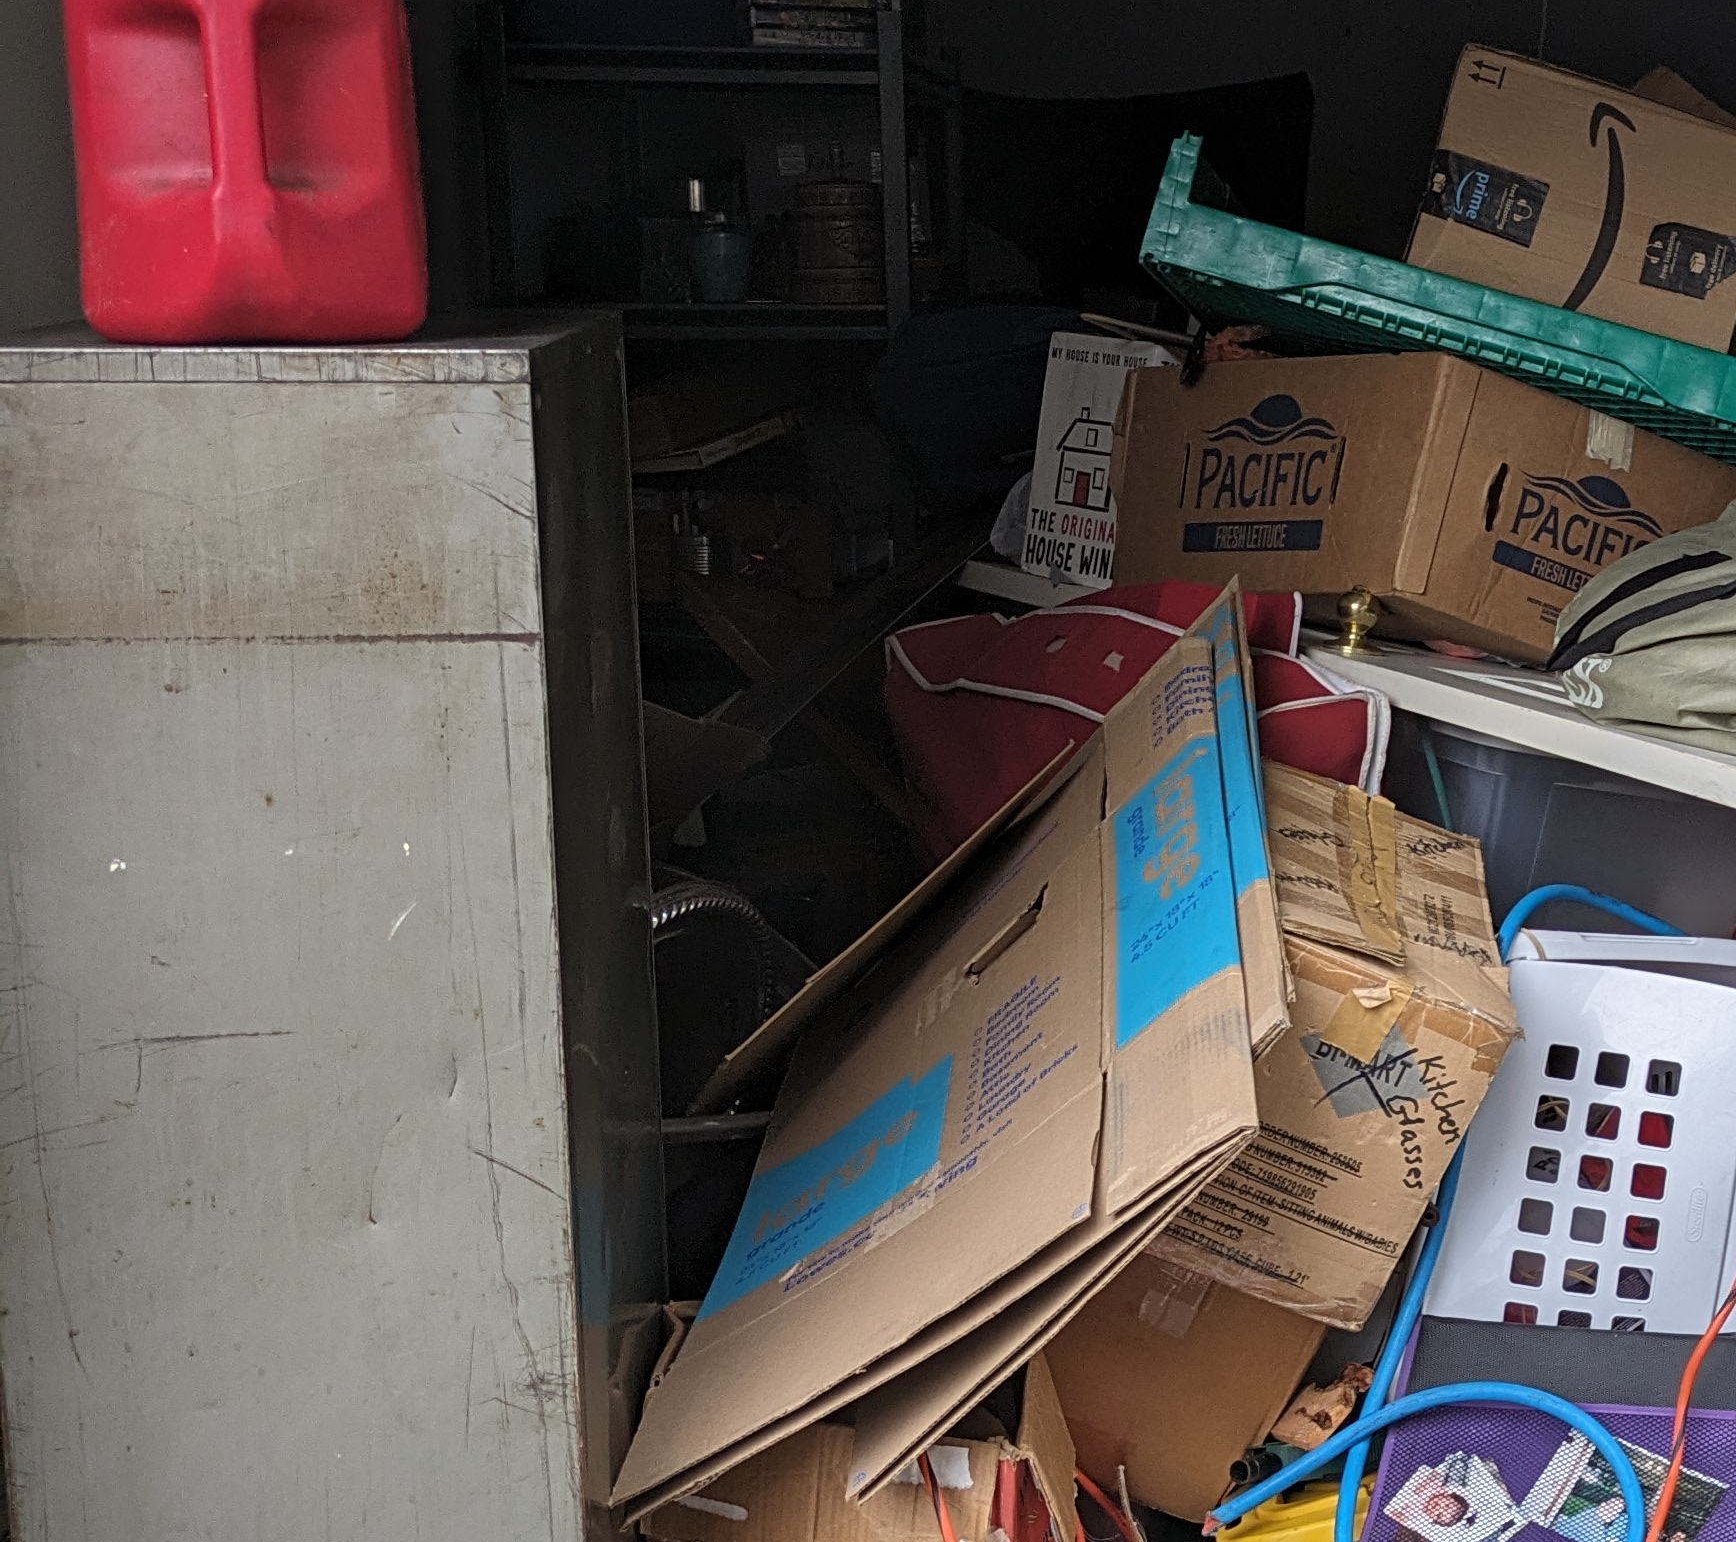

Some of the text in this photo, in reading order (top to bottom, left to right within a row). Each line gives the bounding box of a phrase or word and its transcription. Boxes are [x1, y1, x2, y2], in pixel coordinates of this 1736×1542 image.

[1465, 171, 1491, 220] prime
[1051, 346, 1148, 368] MY HOUSE IS YOUR HOUSE
[1195, 447, 1328, 509] PACIFIC
[1031, 508, 1118, 545] THE ORIGINA
[1214, 523, 1288, 550] FRESH LETTUCE
[1025, 533, 1114, 580] HOUSE WIN
[1530, 557, 1567, 587] FRESH
[1142, 746, 1209, 901] large
[1417, 1055, 1466, 1145] Kitchen
[1386, 1095, 1426, 1190] Glasses
[754, 1110, 920, 1243] large
